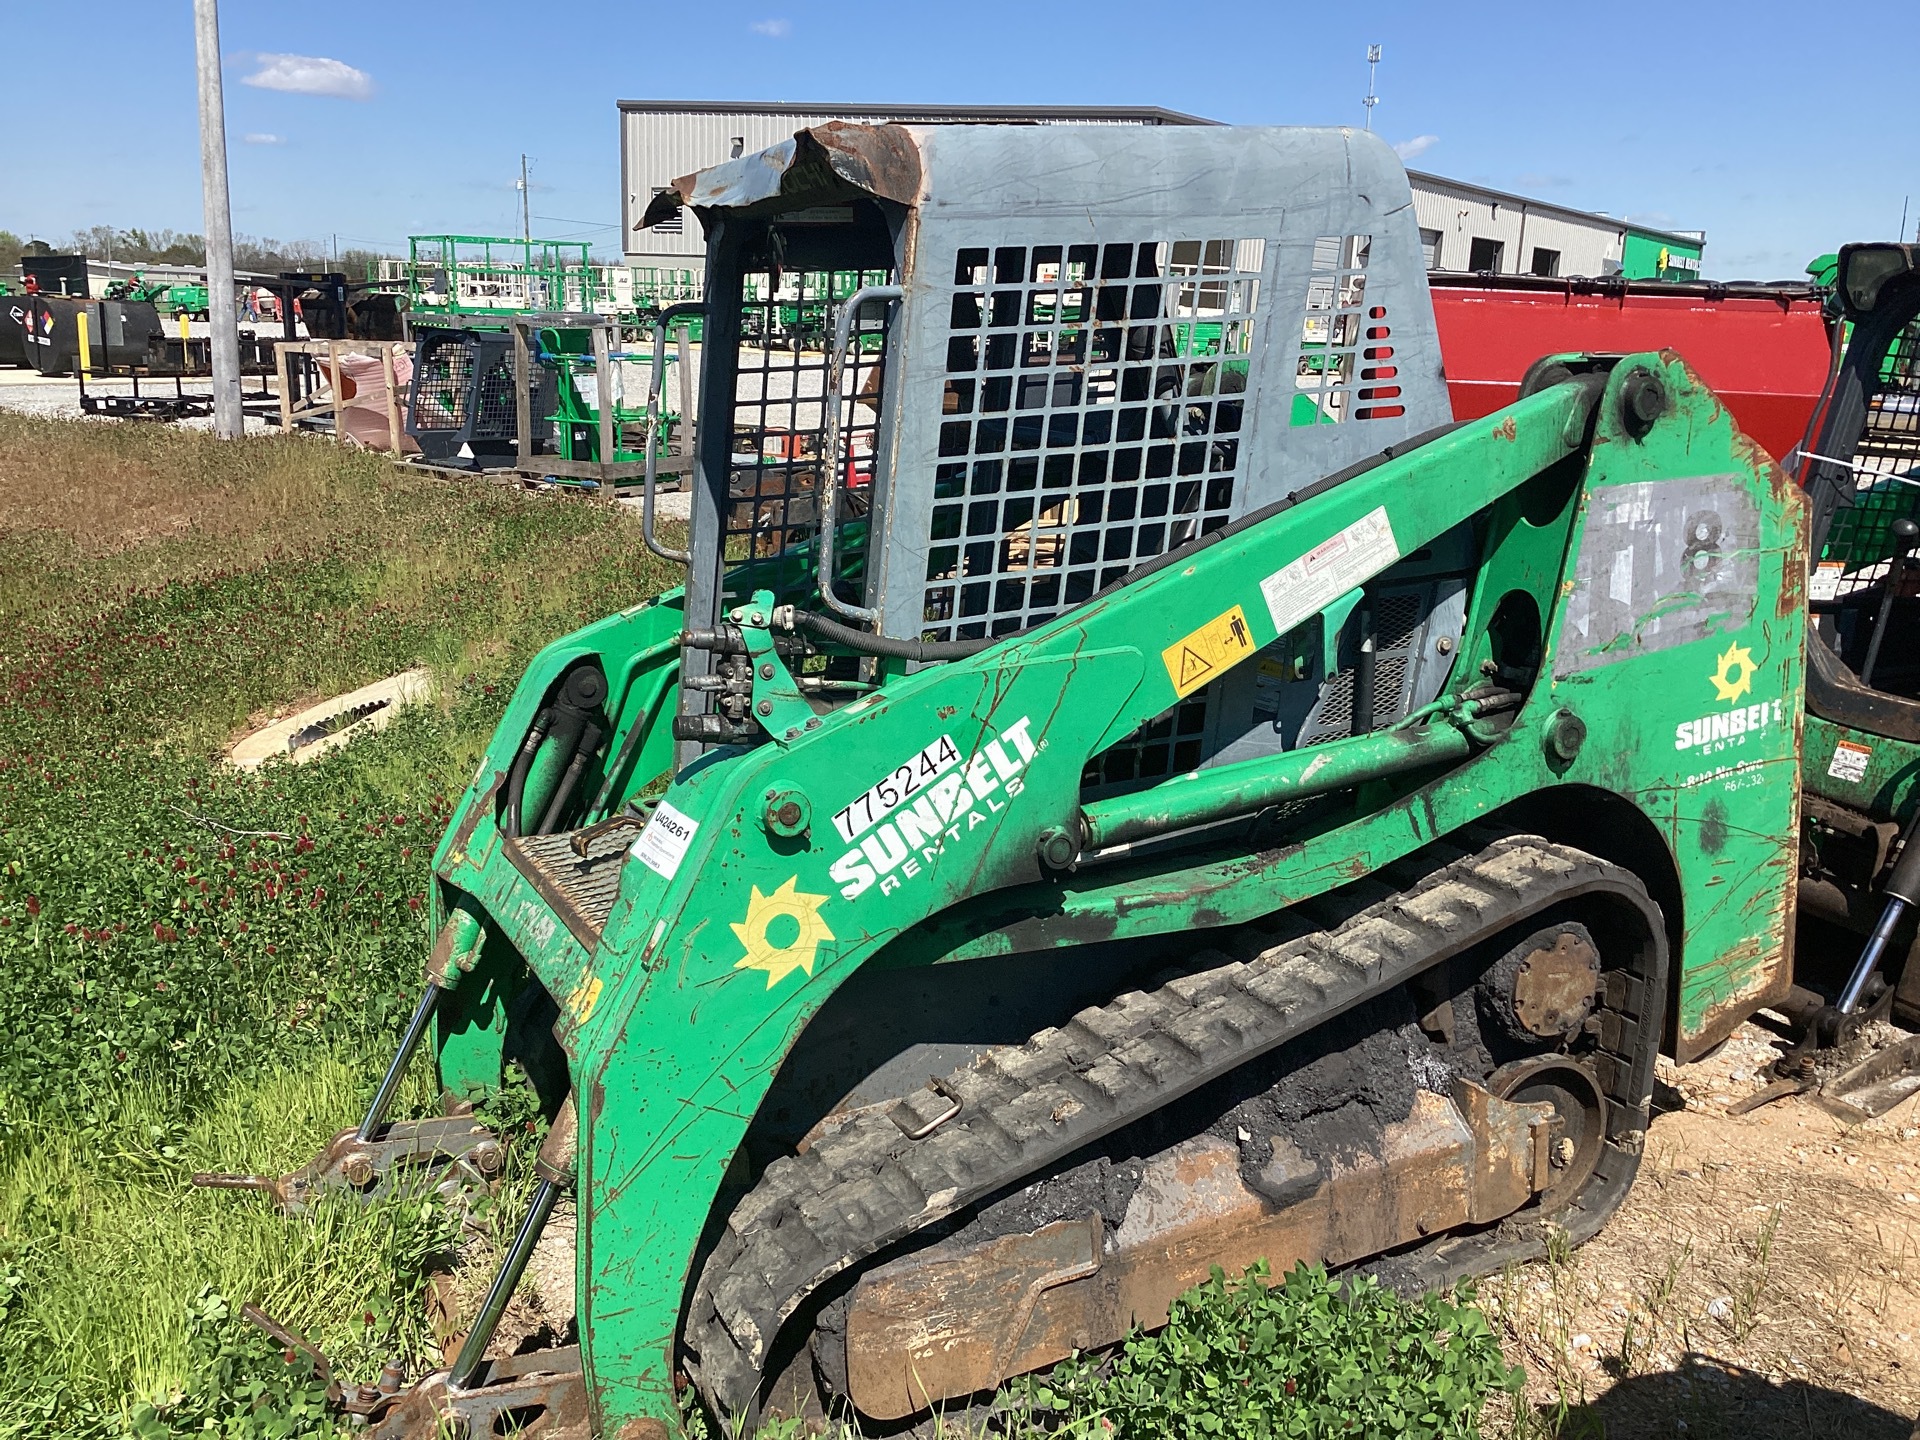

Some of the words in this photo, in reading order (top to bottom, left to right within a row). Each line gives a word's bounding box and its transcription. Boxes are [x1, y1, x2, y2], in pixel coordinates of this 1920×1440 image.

[654, 810, 690, 841] U424261
[828, 715, 1039, 900] SUNBELT
[833, 735, 957, 837] 775244
[878, 776, 1025, 897] RENTALS
